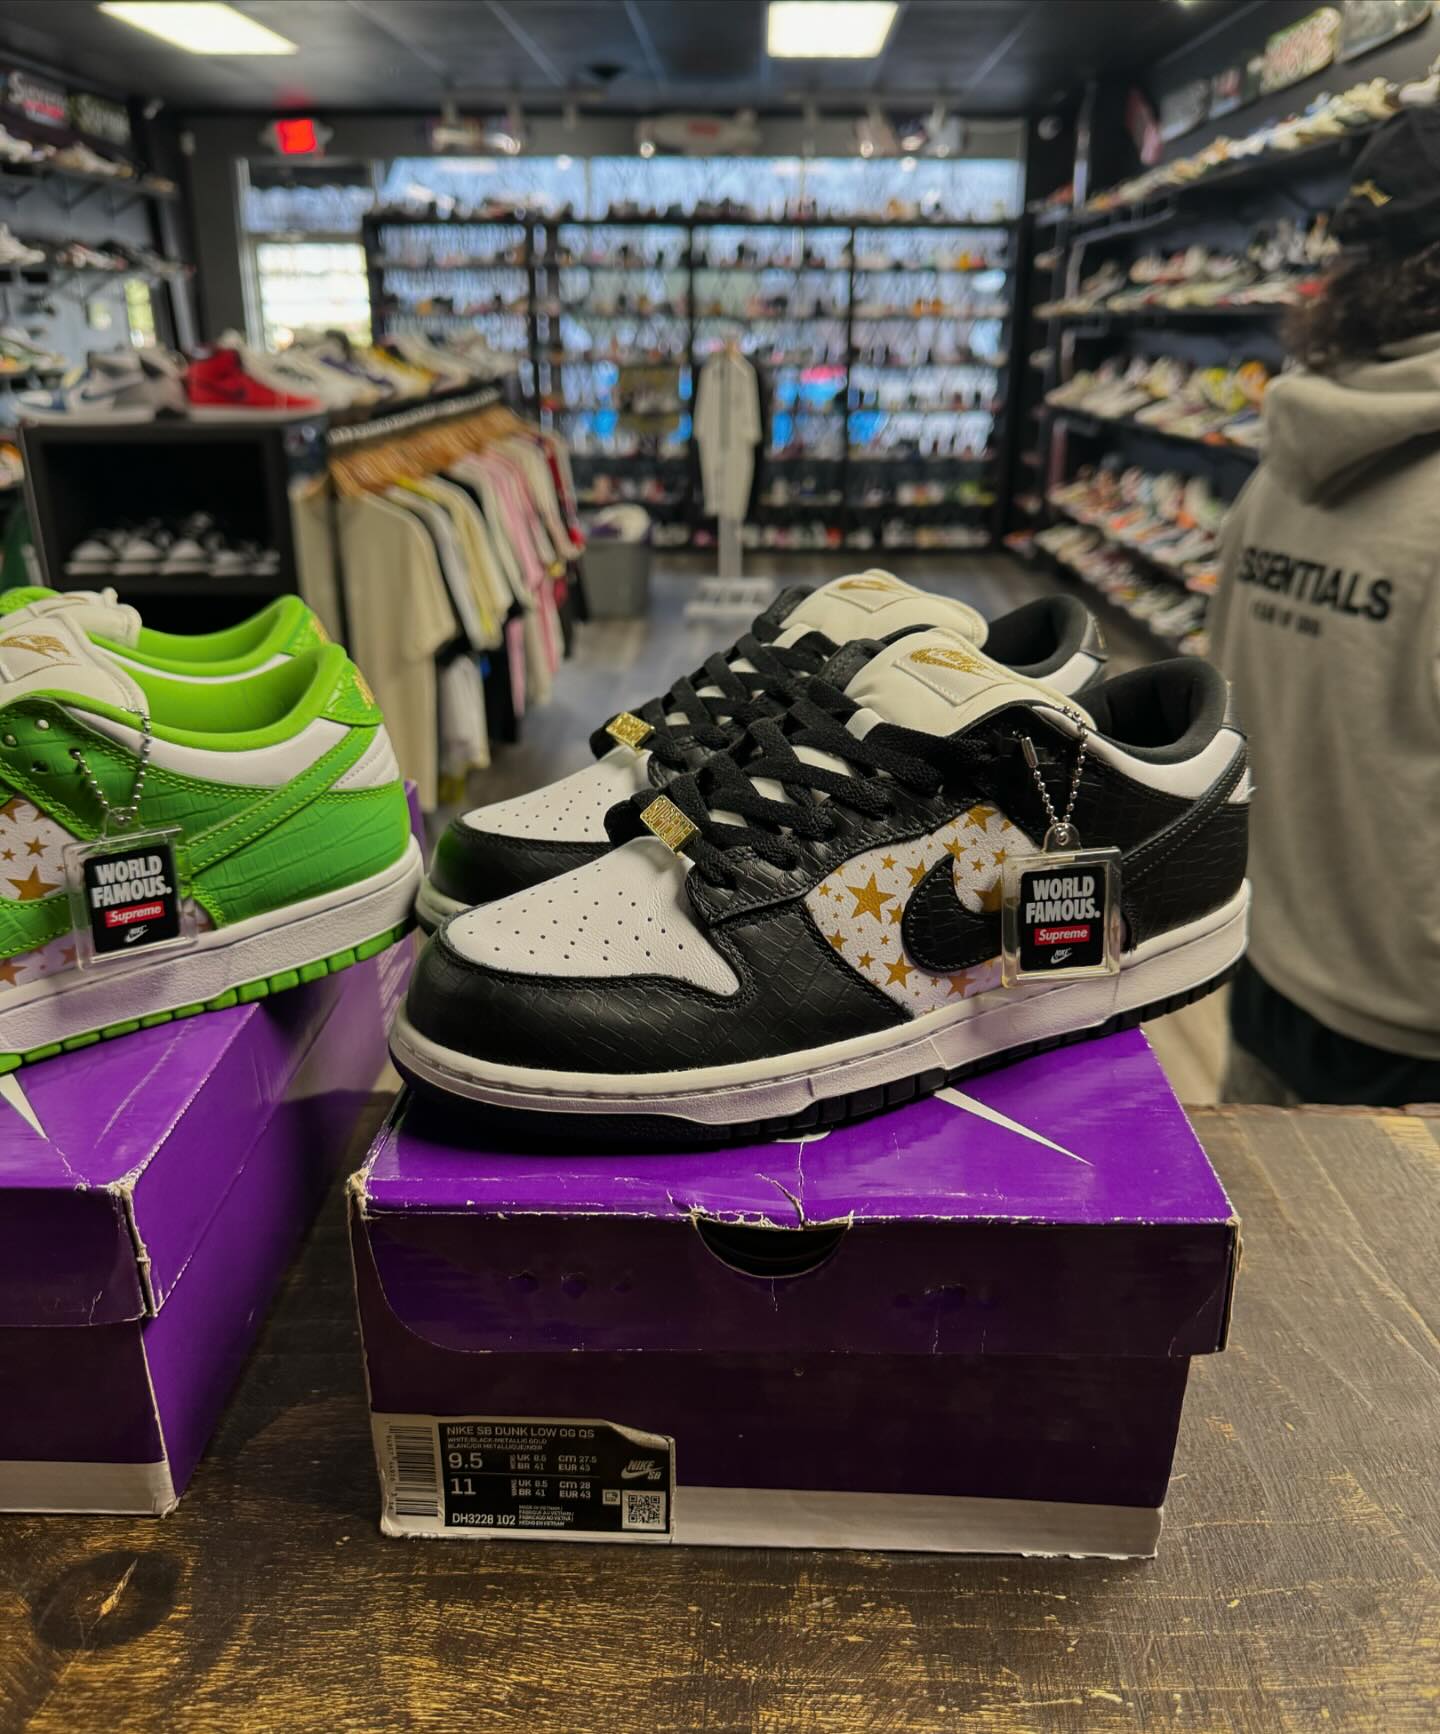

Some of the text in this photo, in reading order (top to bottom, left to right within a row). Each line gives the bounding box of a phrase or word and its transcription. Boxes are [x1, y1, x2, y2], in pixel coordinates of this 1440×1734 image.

[1239, 546, 1392, 624] SSENTIALS
[95, 855, 163, 885] WORLD
[91, 875, 173, 909] FAMOUS.
[1032, 876, 1095, 900] WORLD
[110, 906, 162, 924] Supreme
[1025, 898, 1101, 924] FAMOUS.
[1038, 928, 1088, 944] Supreme
[447, 1426, 474, 1435] NIKE
[476, 1426, 492, 1435] SB
[494, 1427, 528, 1436] DUNK
[530, 1428, 557, 1437] LOW
[448, 1452, 483, 1469] 9.5
[517, 1454, 530, 1462] UK
[578, 1455, 598, 1463] 27.5
[517, 1462, 530, 1470] BR
[534, 1463, 545, 1471] 41
[558, 1463, 577, 1471] EUR
[627, 1459, 656, 1471] NIKE
[450, 1478, 477, 1495] 11
[518, 1479, 532, 1487] UK
[579, 1481, 591, 1489] 28
[518, 1488, 546, 1497] BR 41
[559, 1490, 592, 1498] EUR 43
[452, 1512, 516, 1525] DH3228 102
